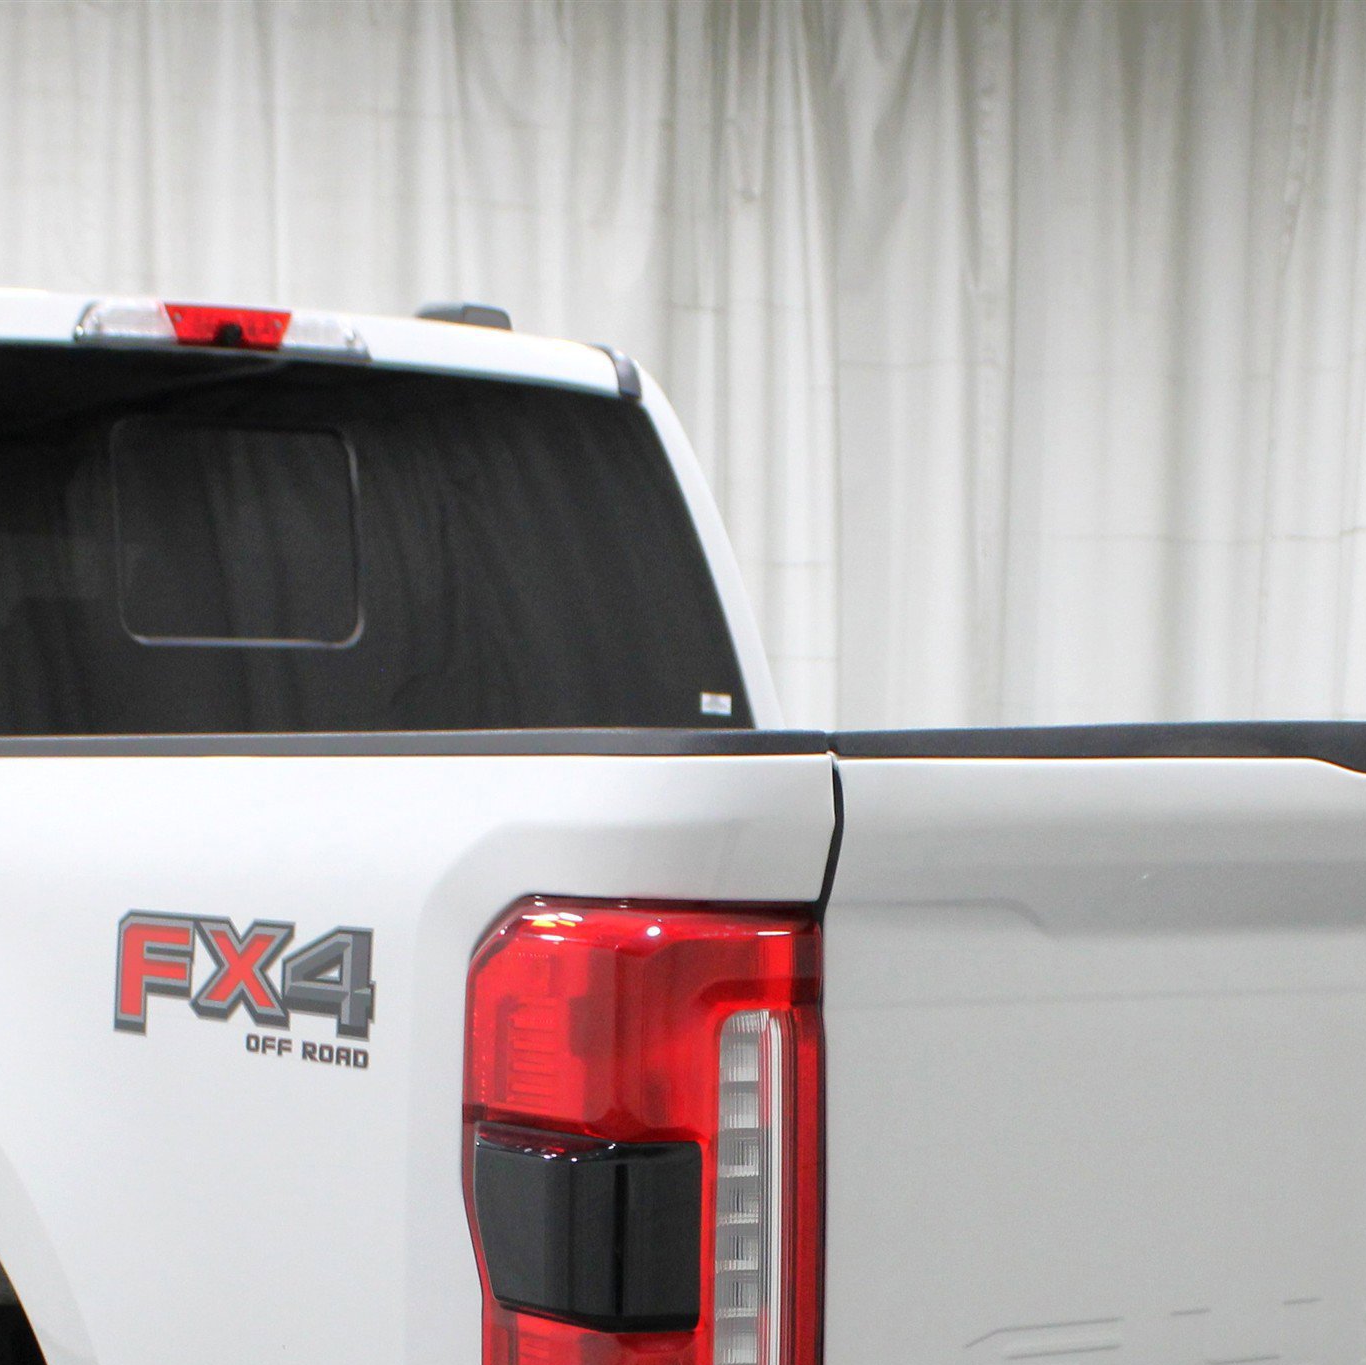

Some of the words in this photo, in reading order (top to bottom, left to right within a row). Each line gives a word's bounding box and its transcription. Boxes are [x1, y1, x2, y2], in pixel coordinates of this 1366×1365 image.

[114, 909, 376, 1041] FX4
[245, 1033, 293, 1057] OFF
[301, 1041, 370, 1070] ROAD
